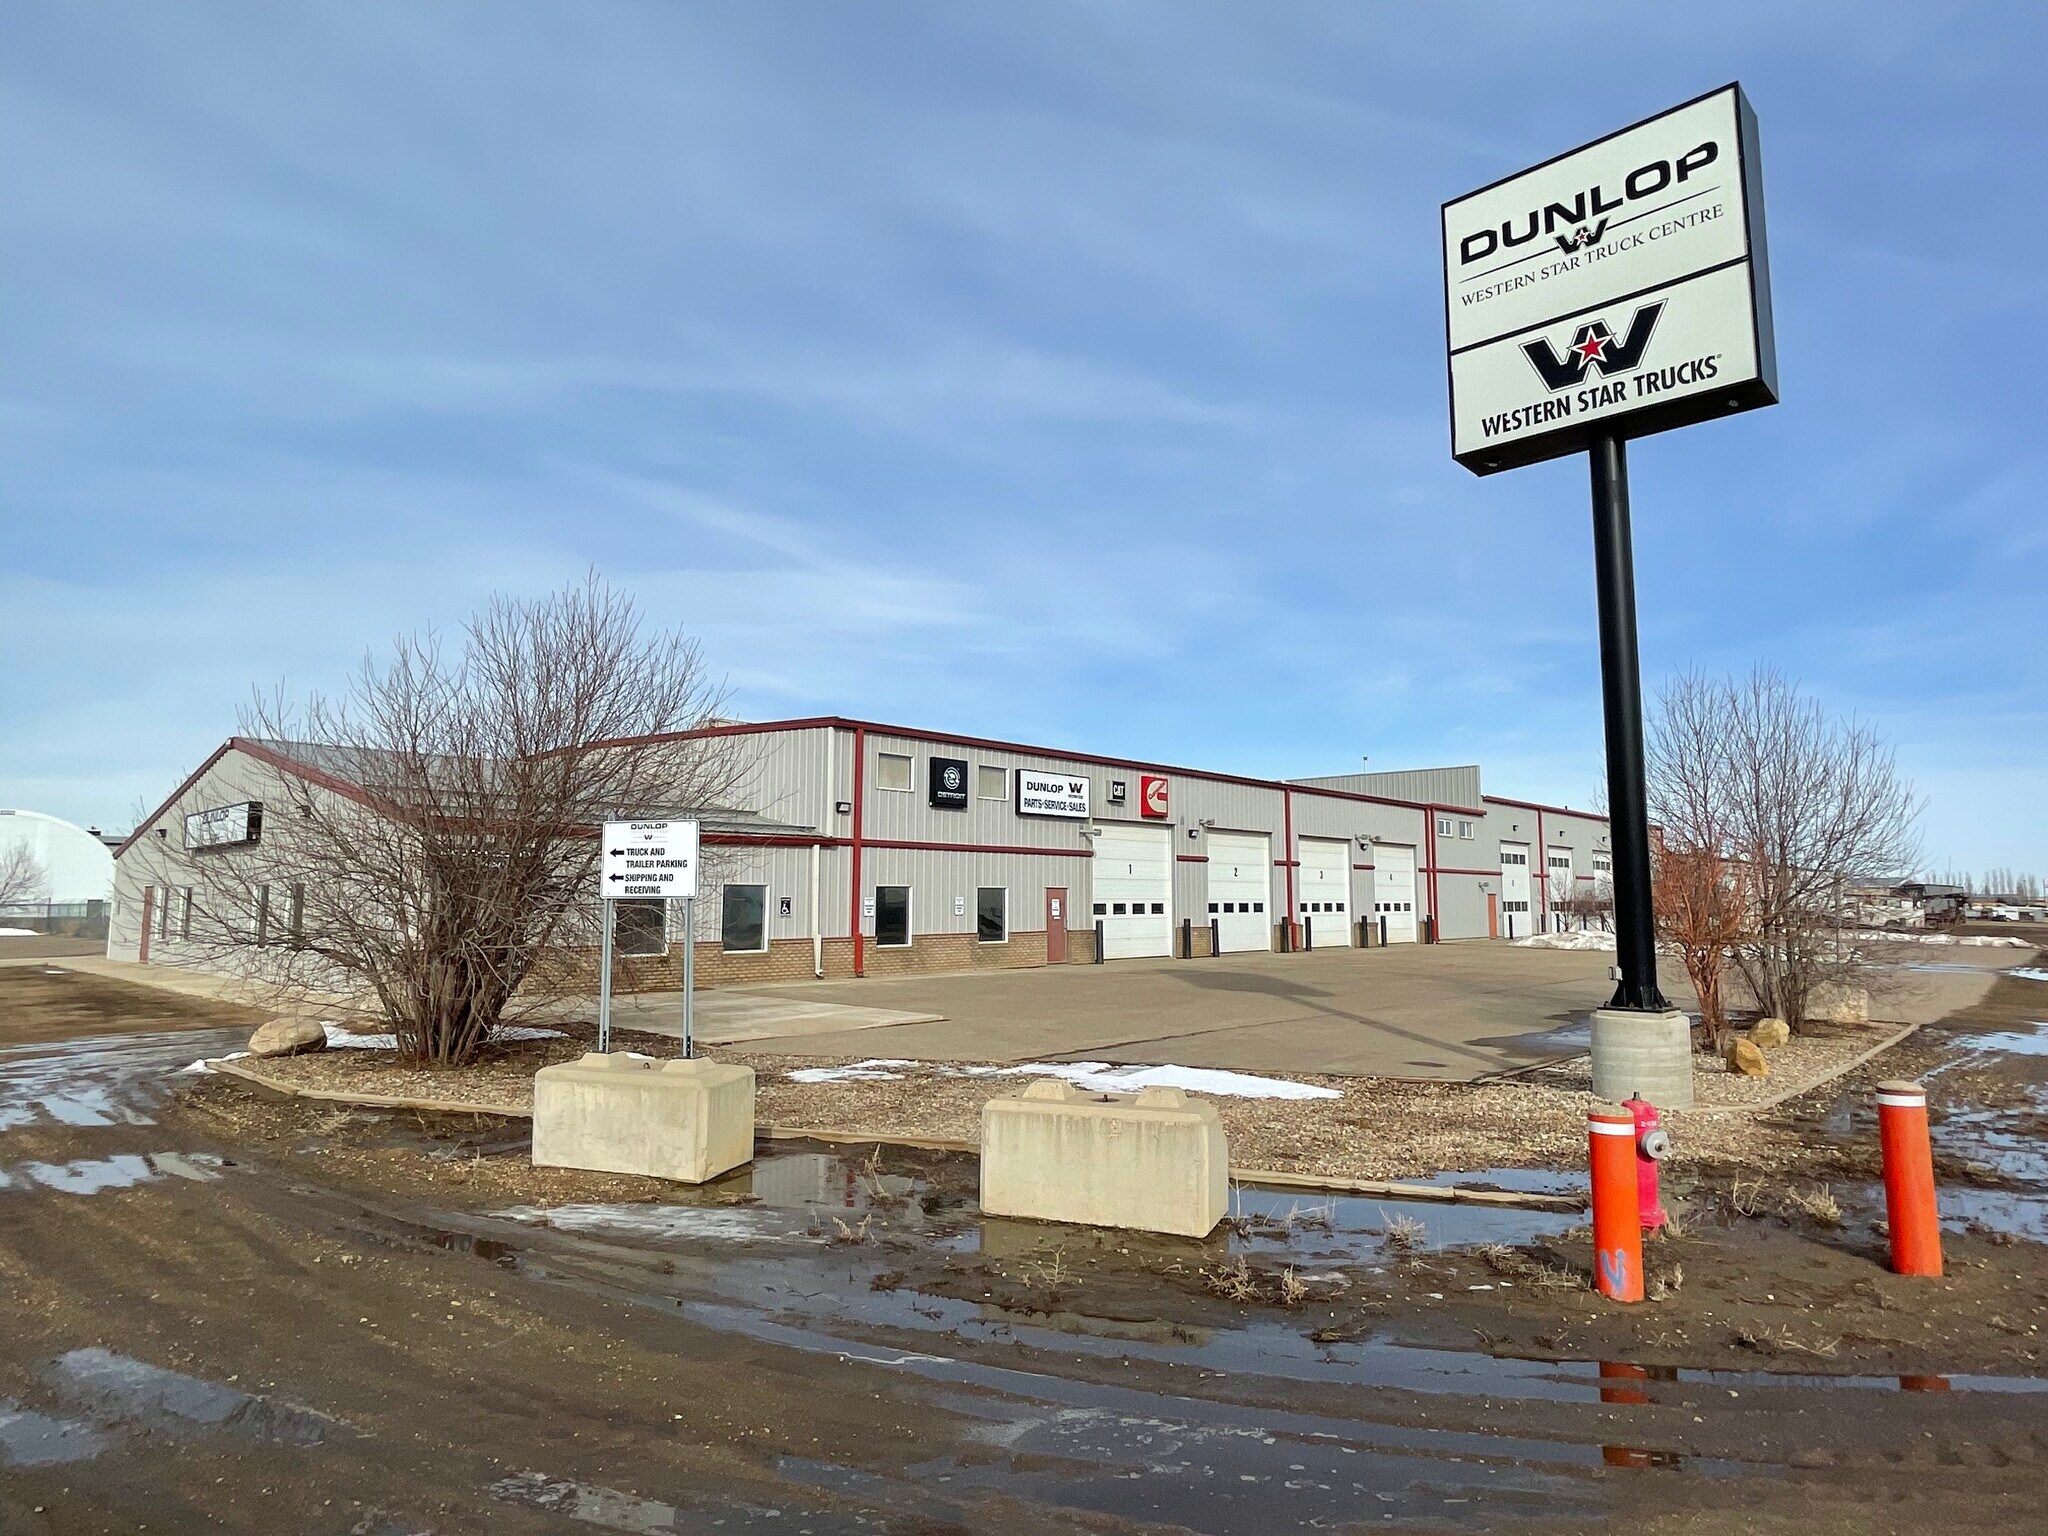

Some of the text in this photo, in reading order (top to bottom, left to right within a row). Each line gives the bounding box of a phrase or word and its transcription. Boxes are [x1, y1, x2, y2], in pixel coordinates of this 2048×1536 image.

[1460, 141, 1718, 265] DUNLOP
[1460, 204, 1725, 307] WESTERN STAR TRUCK CENTRE
[1481, 354, 1718, 438] WESTERN STAR TRUCKS
[1026, 781, 1064, 793] DUNLOP
[626, 848, 665, 856] TRUCK AND
[626, 860, 688, 868] TRAILER PARKING
[1128, 864, 1132, 875] 1
[1233, 867, 1239, 877] 2
[659, 874, 674, 882] AND
[625, 886, 661, 894] RECEIVING
